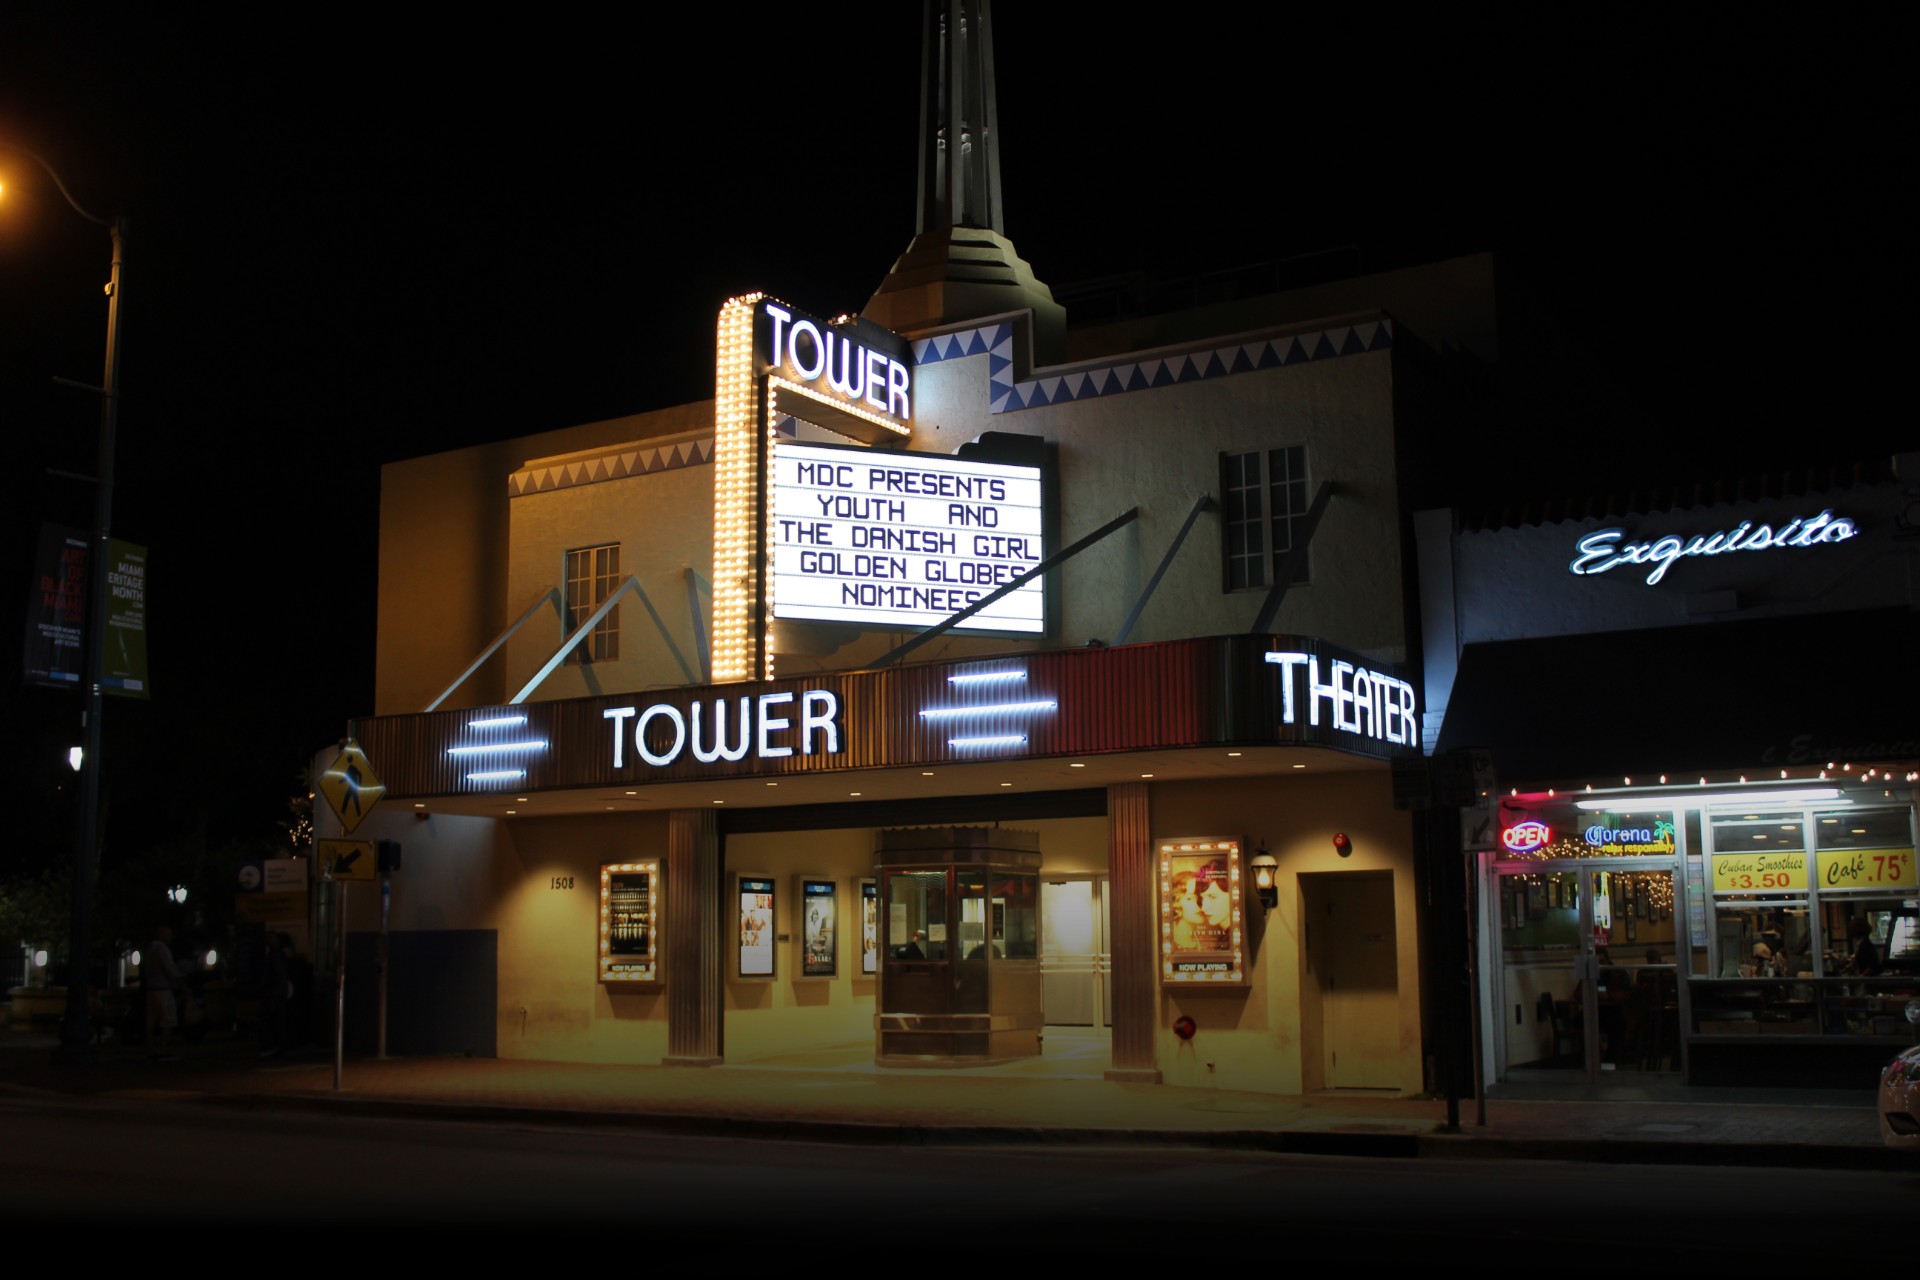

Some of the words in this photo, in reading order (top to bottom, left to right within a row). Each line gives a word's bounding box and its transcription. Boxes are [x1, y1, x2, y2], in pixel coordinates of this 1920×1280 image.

[766, 304, 909, 420] TOWER
[797, 462, 853, 488] MDC
[869, 468, 1006, 501] PRESENTS
[817, 494, 905, 522] YOUTH
[948, 503, 998, 528] AND
[779, 520, 833, 545] THE
[851, 526, 956, 554] DANISH
[973, 535, 1040, 561] GIRL
[1569, 509, 1855, 586] Exquisito
[118, 562, 143, 577] MIAMI
[800, 551, 907, 579] GOLDEN
[112, 585, 143, 601] MONTH
[1265, 652, 1417, 748] THEATER
[603, 689, 838, 768] TOWER
[1502, 826, 1550, 846] OPEN
[1584, 825, 1652, 847] Corona
[1718, 859, 1753, 876] Cuban
[1756, 852, 1803, 873] Smoothies
[1826, 854, 1865, 885] Café
[551, 876, 575, 891] 1508
[1730, 872, 1790, 890] $3.50
[1178, 963, 1196, 972] NOW
[1197, 963, 1228, 971] PLAYING
